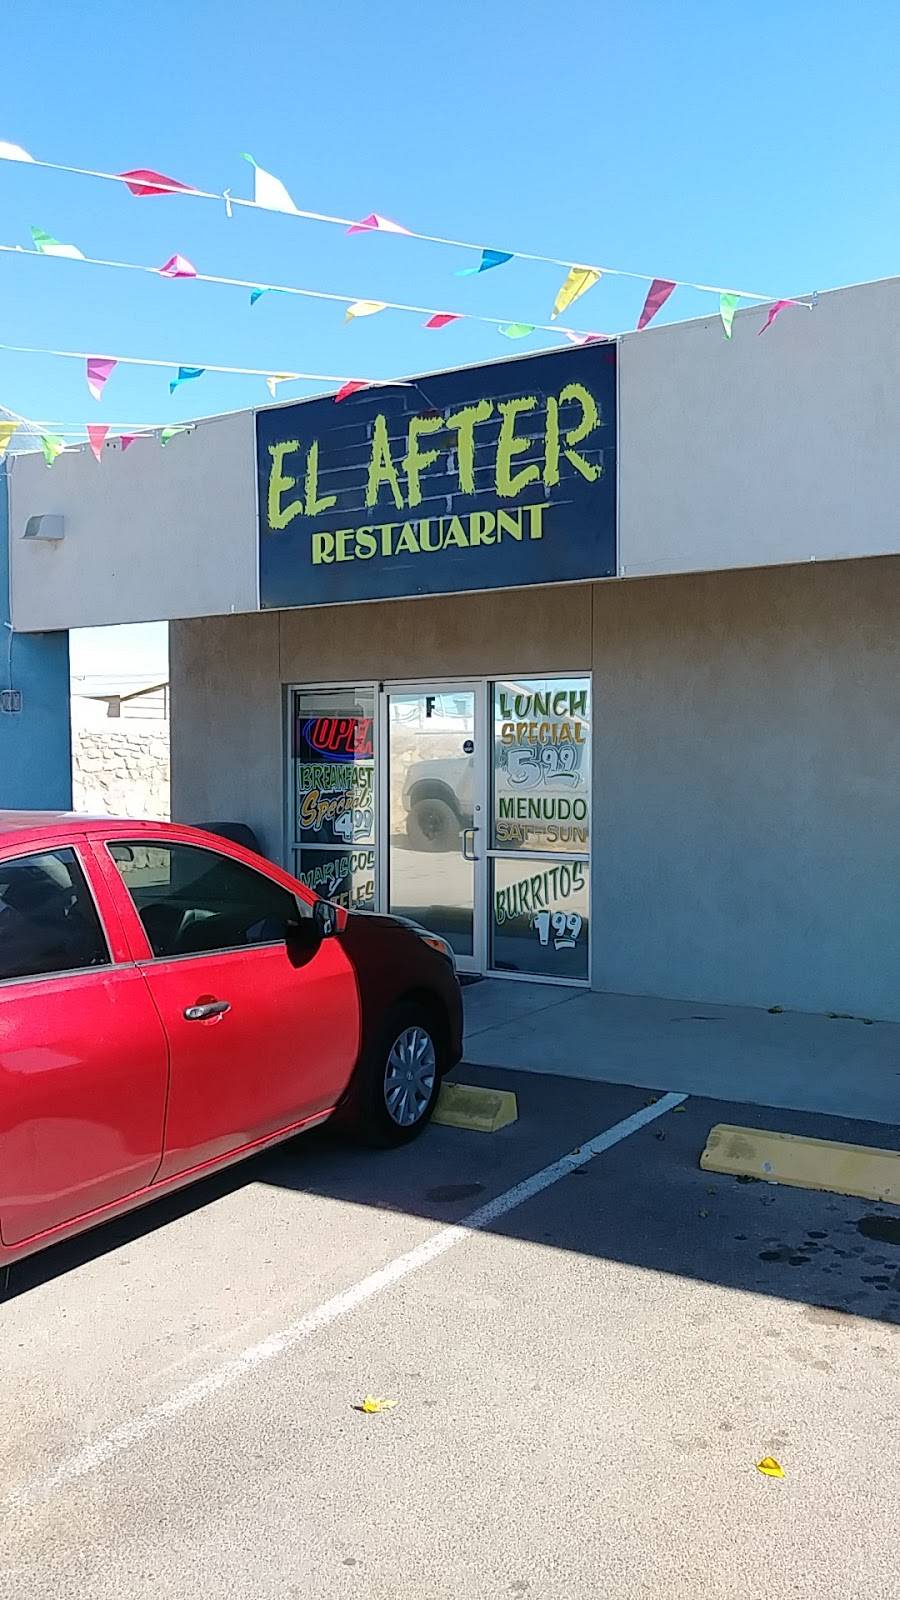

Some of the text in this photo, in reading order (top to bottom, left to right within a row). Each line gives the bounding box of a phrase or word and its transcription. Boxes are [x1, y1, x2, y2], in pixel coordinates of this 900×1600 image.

[267, 382, 602, 530] EL AFTER
[312, 503, 549, 565] RESTAUARNT
[425, 696, 436, 718] F
[499, 689, 588, 719] LUNCH
[312, 716, 372, 754] OPE
[501, 721, 586, 746] SPECIAL
[299, 764, 374, 790] BREAKFAST
[499, 797, 588, 820] MENUDO
[300, 851, 375, 889] MARISCOS
[494, 861, 585, 925] BURRITOS
